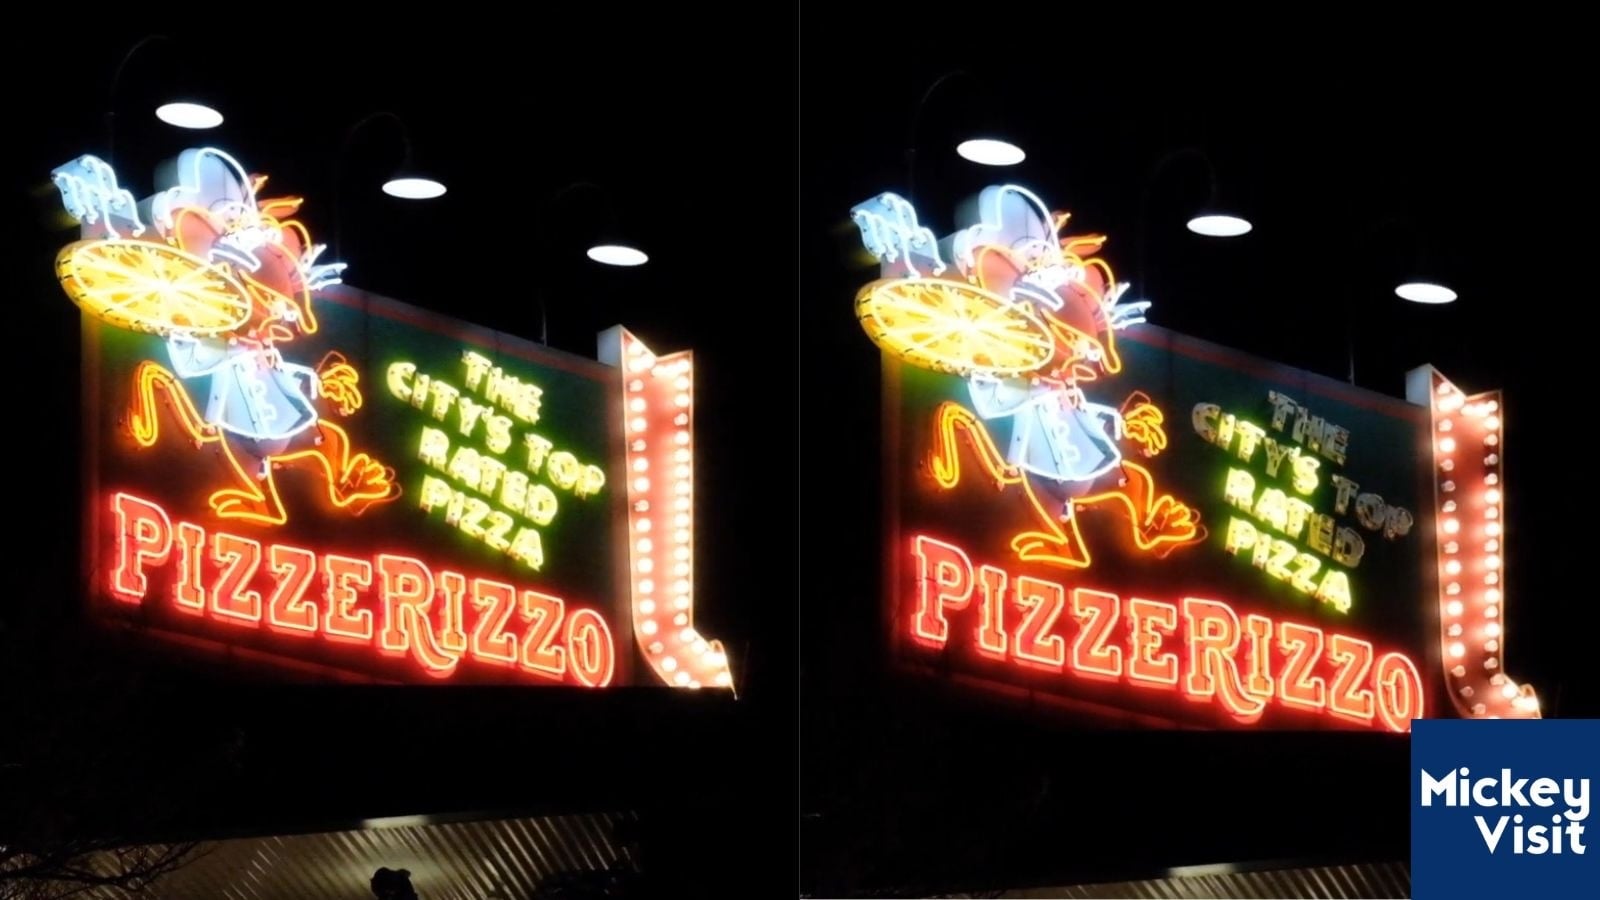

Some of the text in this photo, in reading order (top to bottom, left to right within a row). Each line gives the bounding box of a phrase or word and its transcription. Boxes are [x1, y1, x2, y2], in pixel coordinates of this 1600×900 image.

[387, 362, 605, 500] CITY'S TOP
[462, 351, 543, 424] THE
[1269, 390, 1350, 465] THE
[418, 426, 558, 526] RATED
[1192, 402, 1413, 541] CITY'S TOP
[1225, 467, 1364, 567] RATED
[420, 475, 543, 571] PIZZA
[1226, 516, 1351, 614] PIZZA
